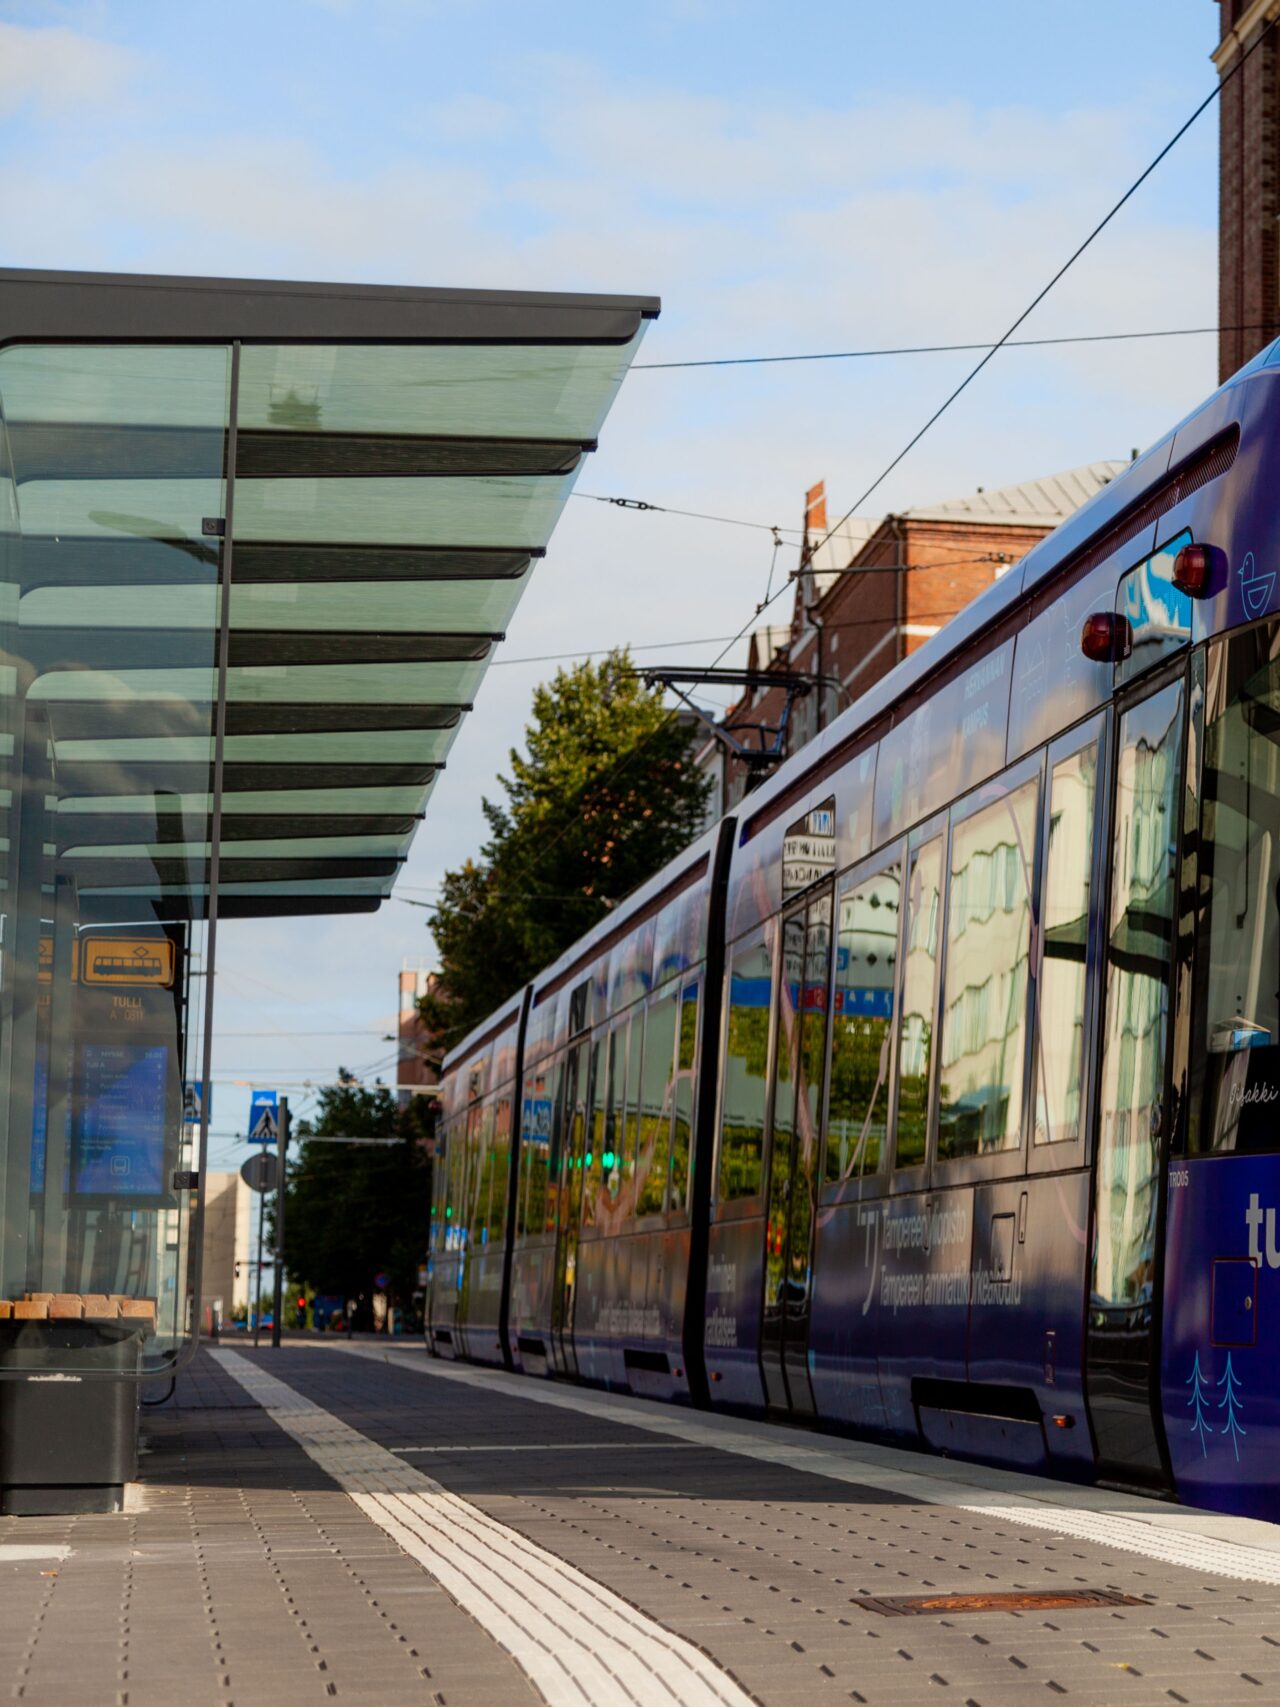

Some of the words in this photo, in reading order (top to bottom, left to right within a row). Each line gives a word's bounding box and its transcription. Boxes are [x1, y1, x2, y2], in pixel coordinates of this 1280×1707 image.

[112, 995, 142, 1008] TULLI
[880, 1208, 930, 1259] Tampereen
[880, 1264, 924, 1316] Tampereen
